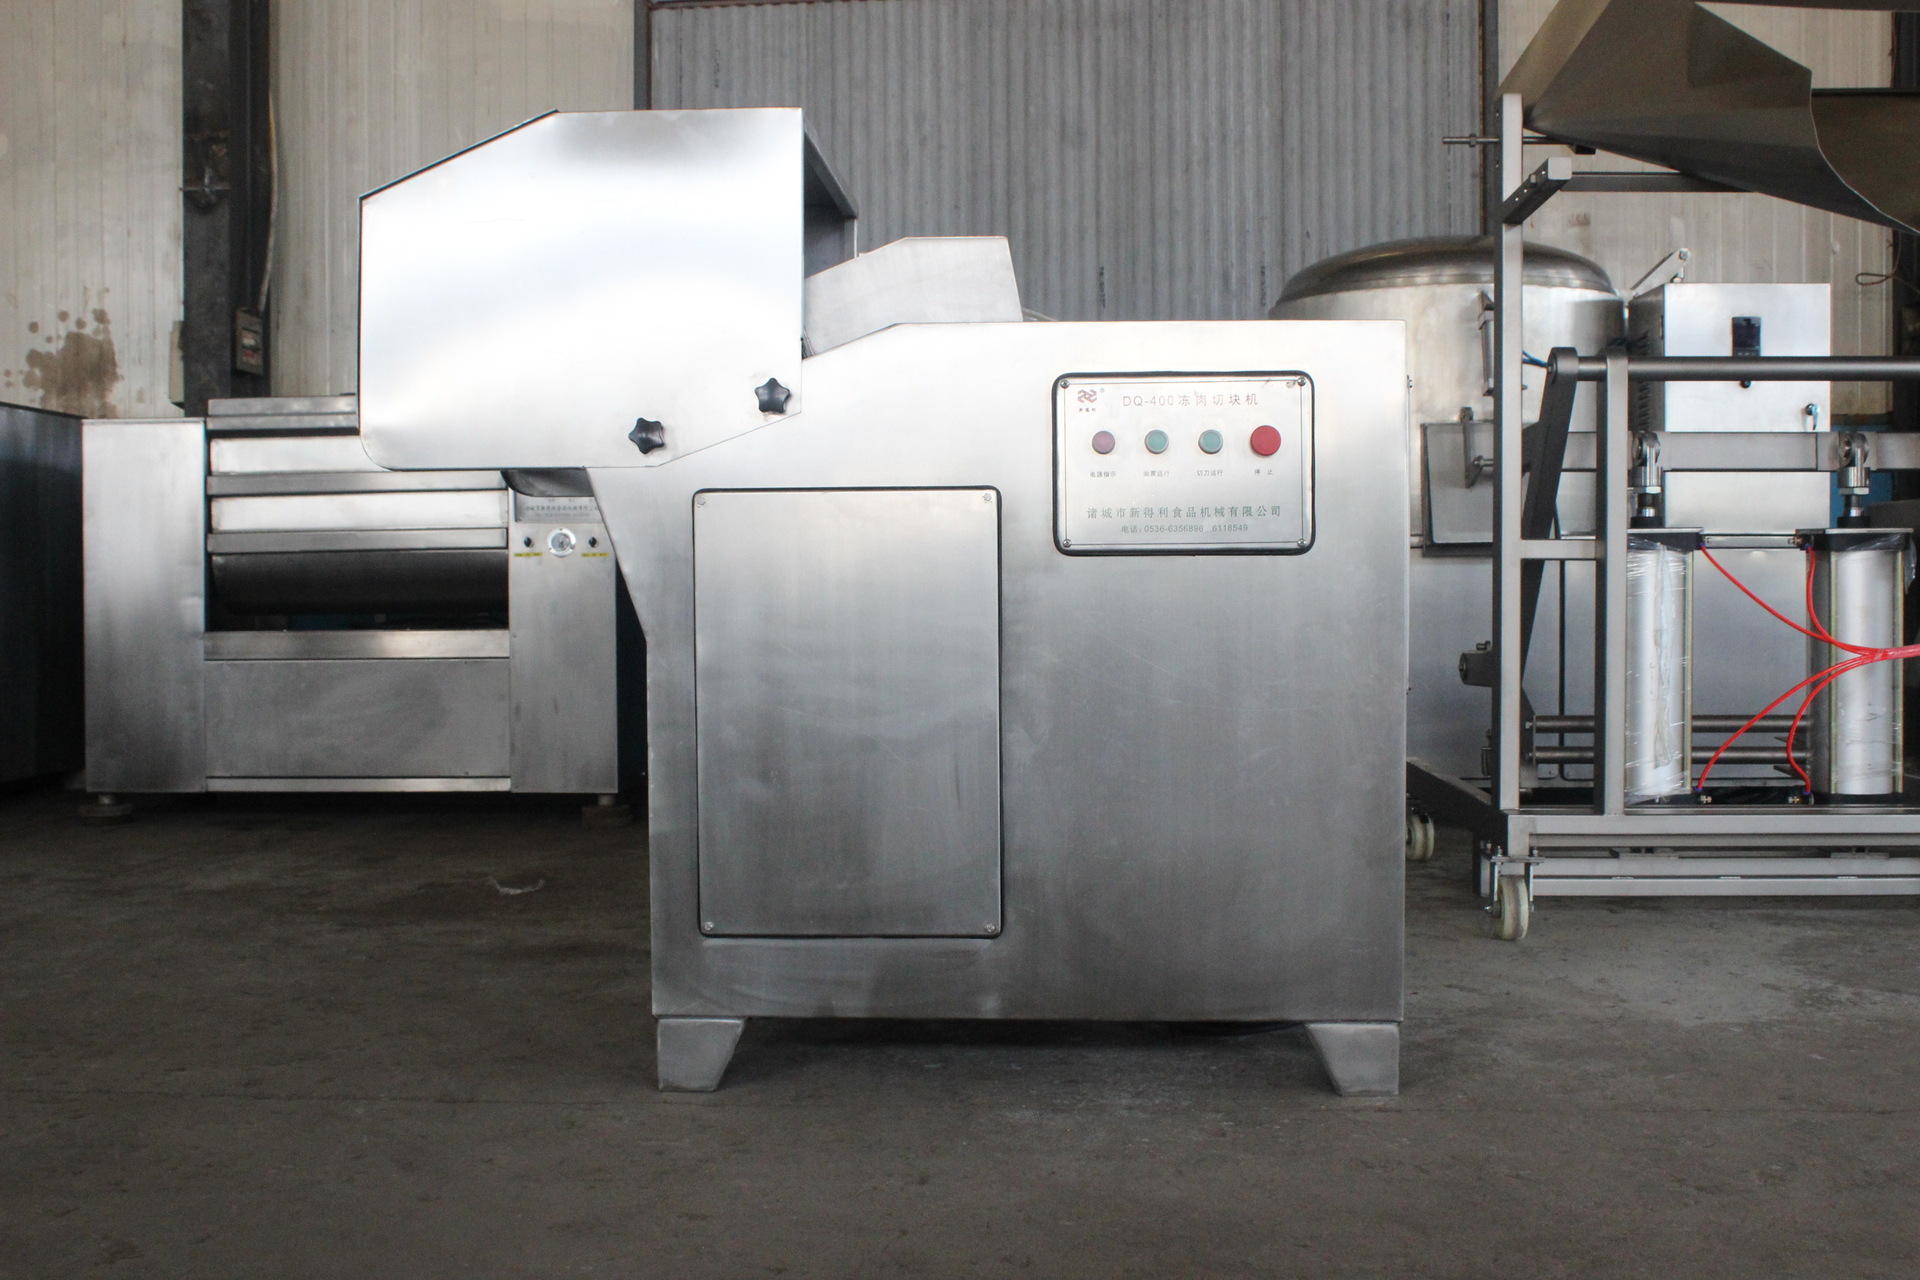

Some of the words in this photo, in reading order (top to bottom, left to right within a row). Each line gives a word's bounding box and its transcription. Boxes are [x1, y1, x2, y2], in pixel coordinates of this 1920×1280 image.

[1086, 505, 1281, 519] 诸城市新得利食品机械有限公司
[1211, 523, 1249, 533] 6118549
